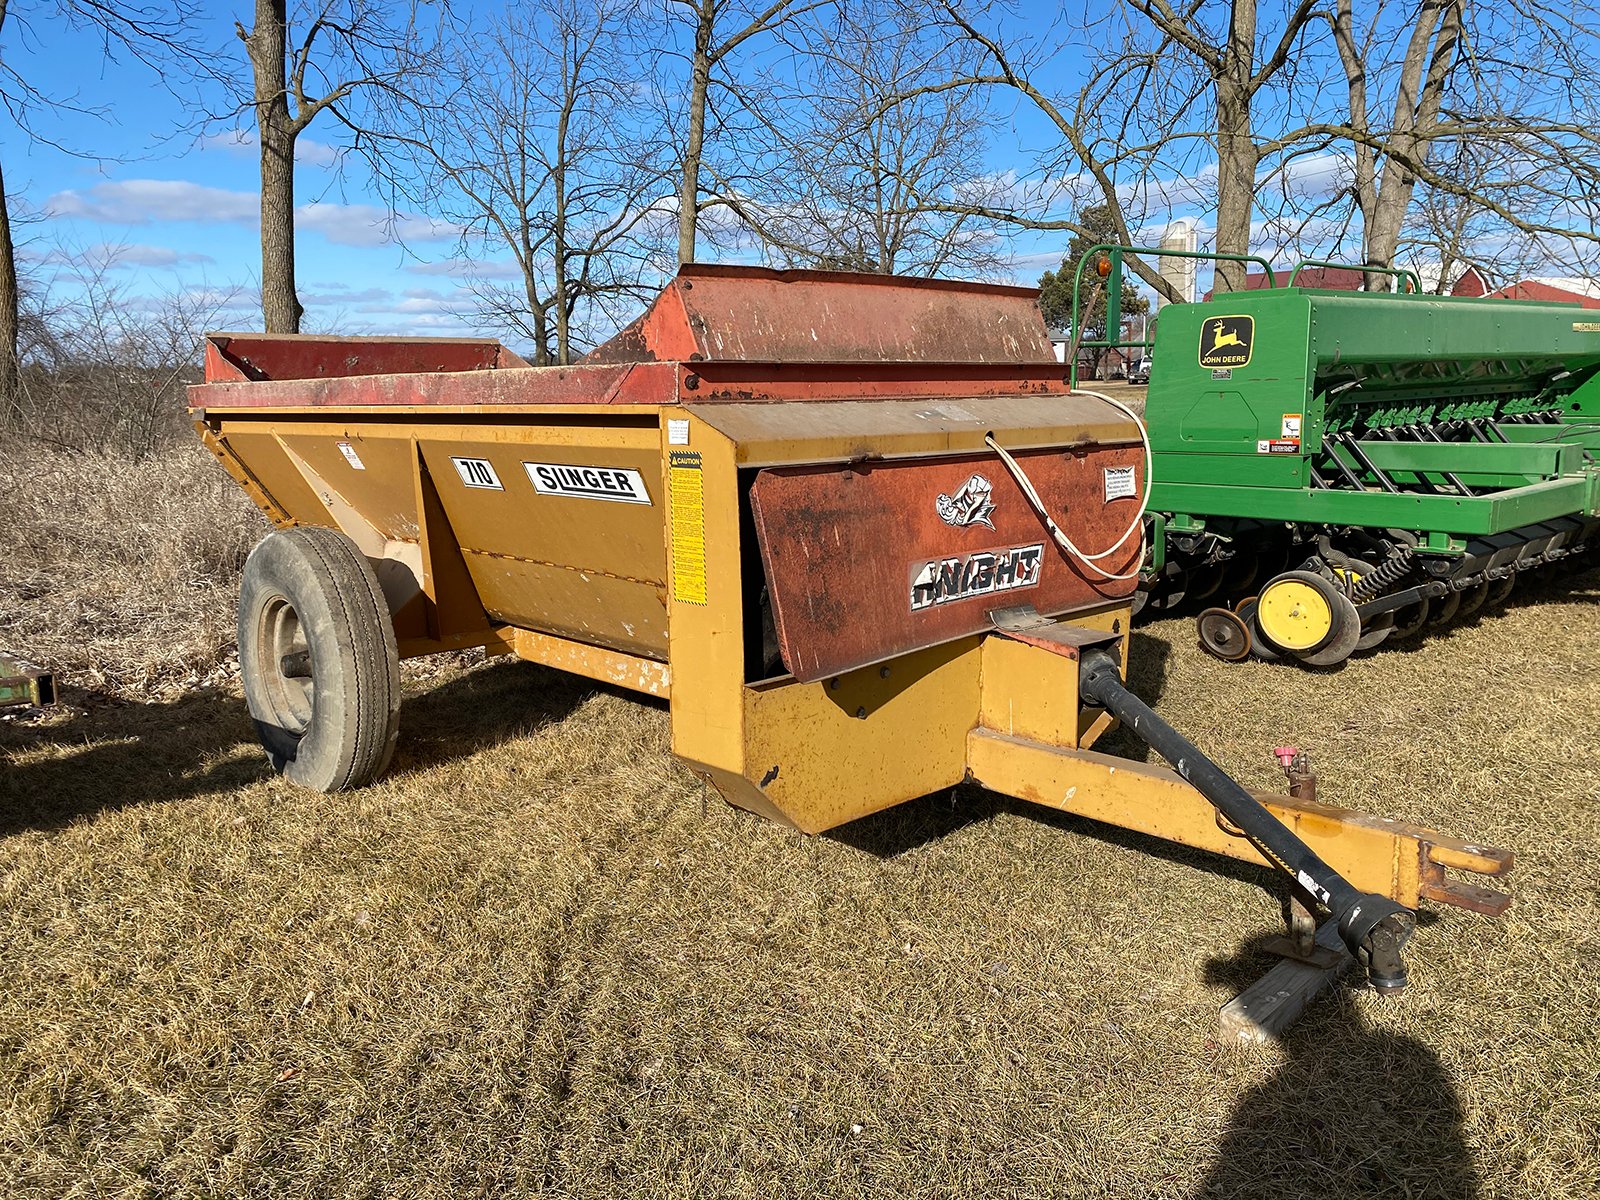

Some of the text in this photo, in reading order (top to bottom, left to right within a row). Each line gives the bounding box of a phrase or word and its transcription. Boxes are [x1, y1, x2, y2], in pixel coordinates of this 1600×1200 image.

[1222, 355, 1247, 363] DEERE
[677, 457, 700, 465] CAUTION
[460, 460, 494, 485] 710
[536, 466, 637, 498] SLINGER
